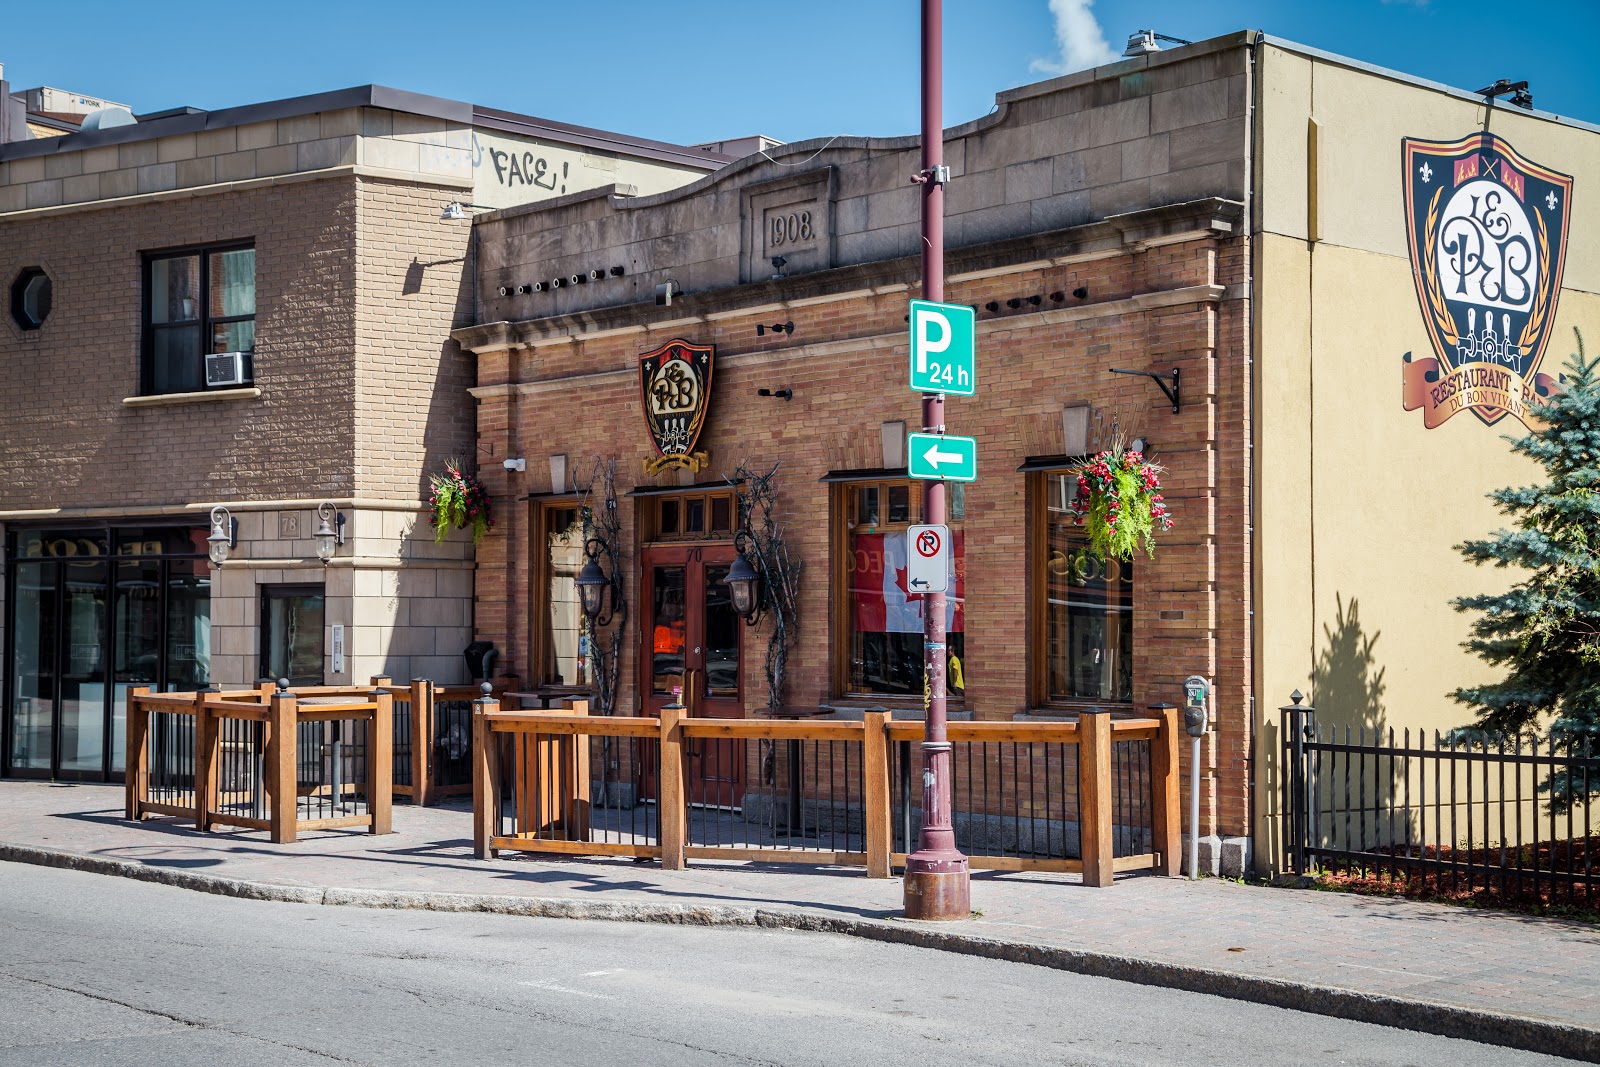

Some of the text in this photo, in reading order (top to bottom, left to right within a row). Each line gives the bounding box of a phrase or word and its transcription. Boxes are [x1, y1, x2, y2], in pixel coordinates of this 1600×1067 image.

[85, 99, 101, 108] YORK
[916, 309, 952, 374] P
[929, 362, 969, 386] 24 h
[1430, 368, 1511, 409] RESTAURANT
[1449, 390, 1528, 418] DU BON VIVANT
[281, 517, 297, 531] 78
[687, 547, 702, 563] 70
